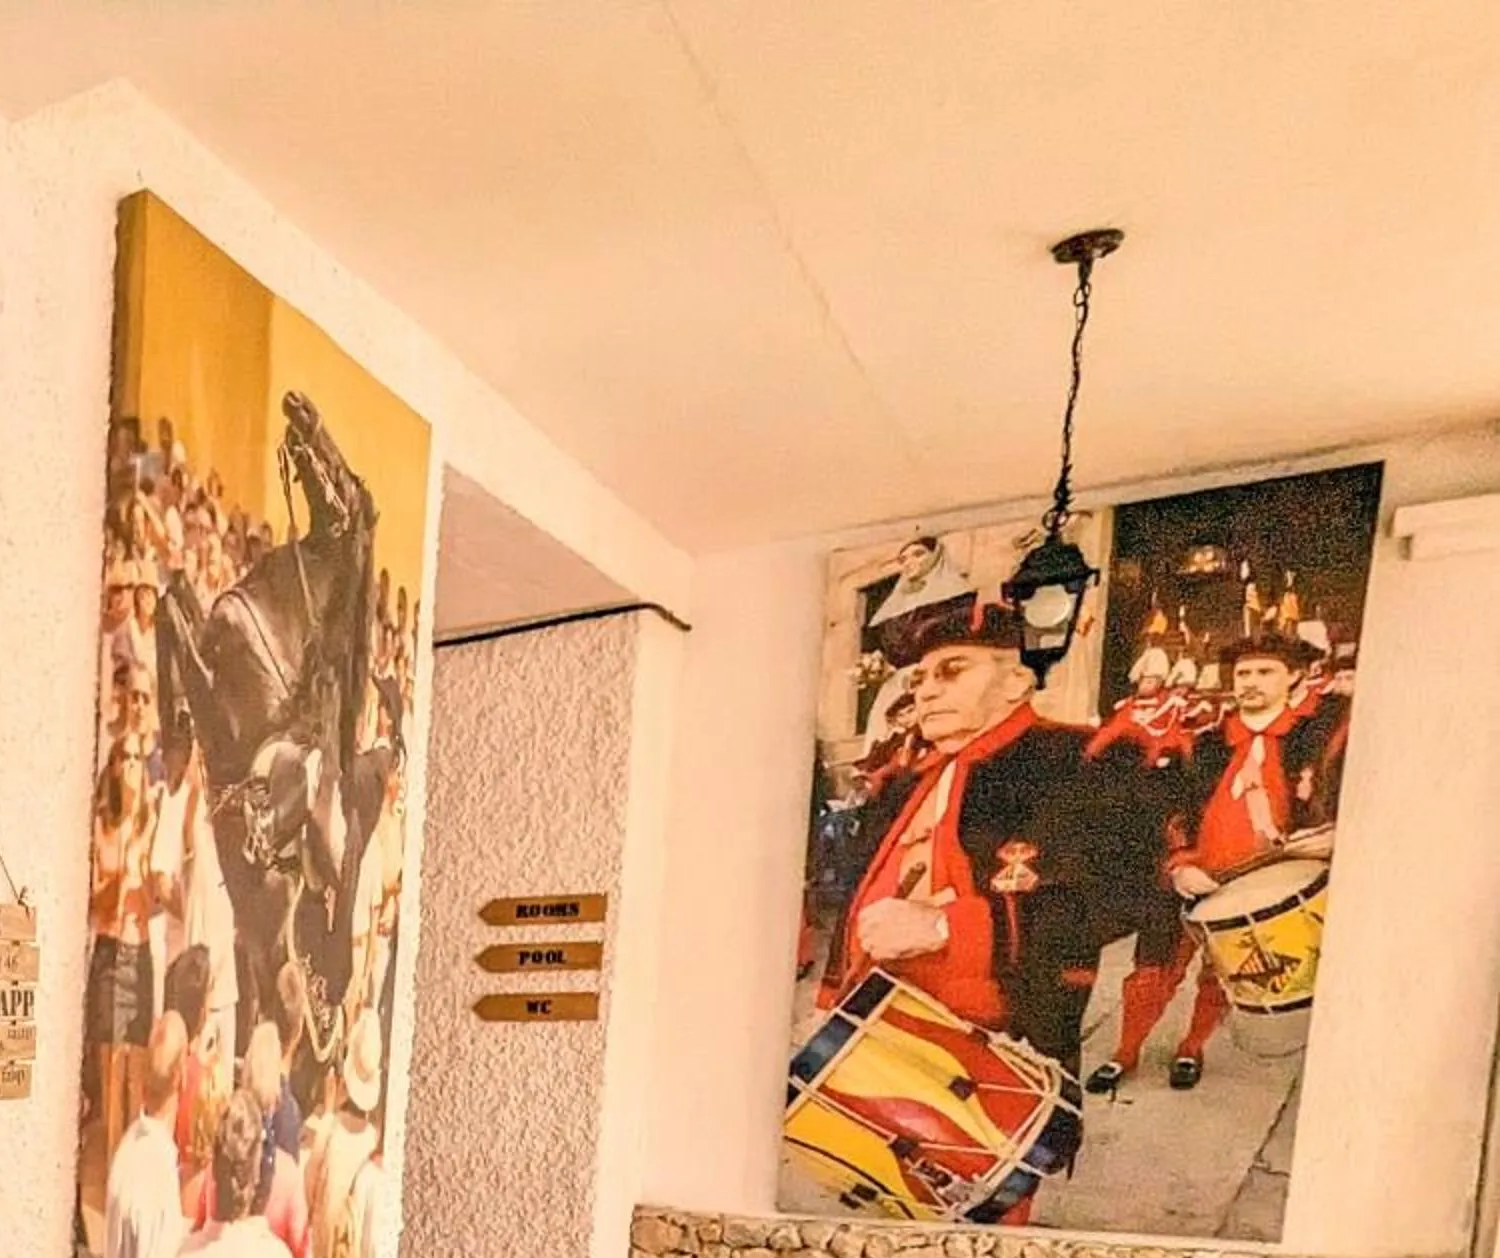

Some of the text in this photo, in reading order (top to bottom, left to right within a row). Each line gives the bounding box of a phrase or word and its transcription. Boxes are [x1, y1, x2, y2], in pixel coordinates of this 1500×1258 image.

[515, 902, 580, 918] ROOMS
[518, 949, 567, 966] POOL
[526, 1000, 552, 1015] WC
